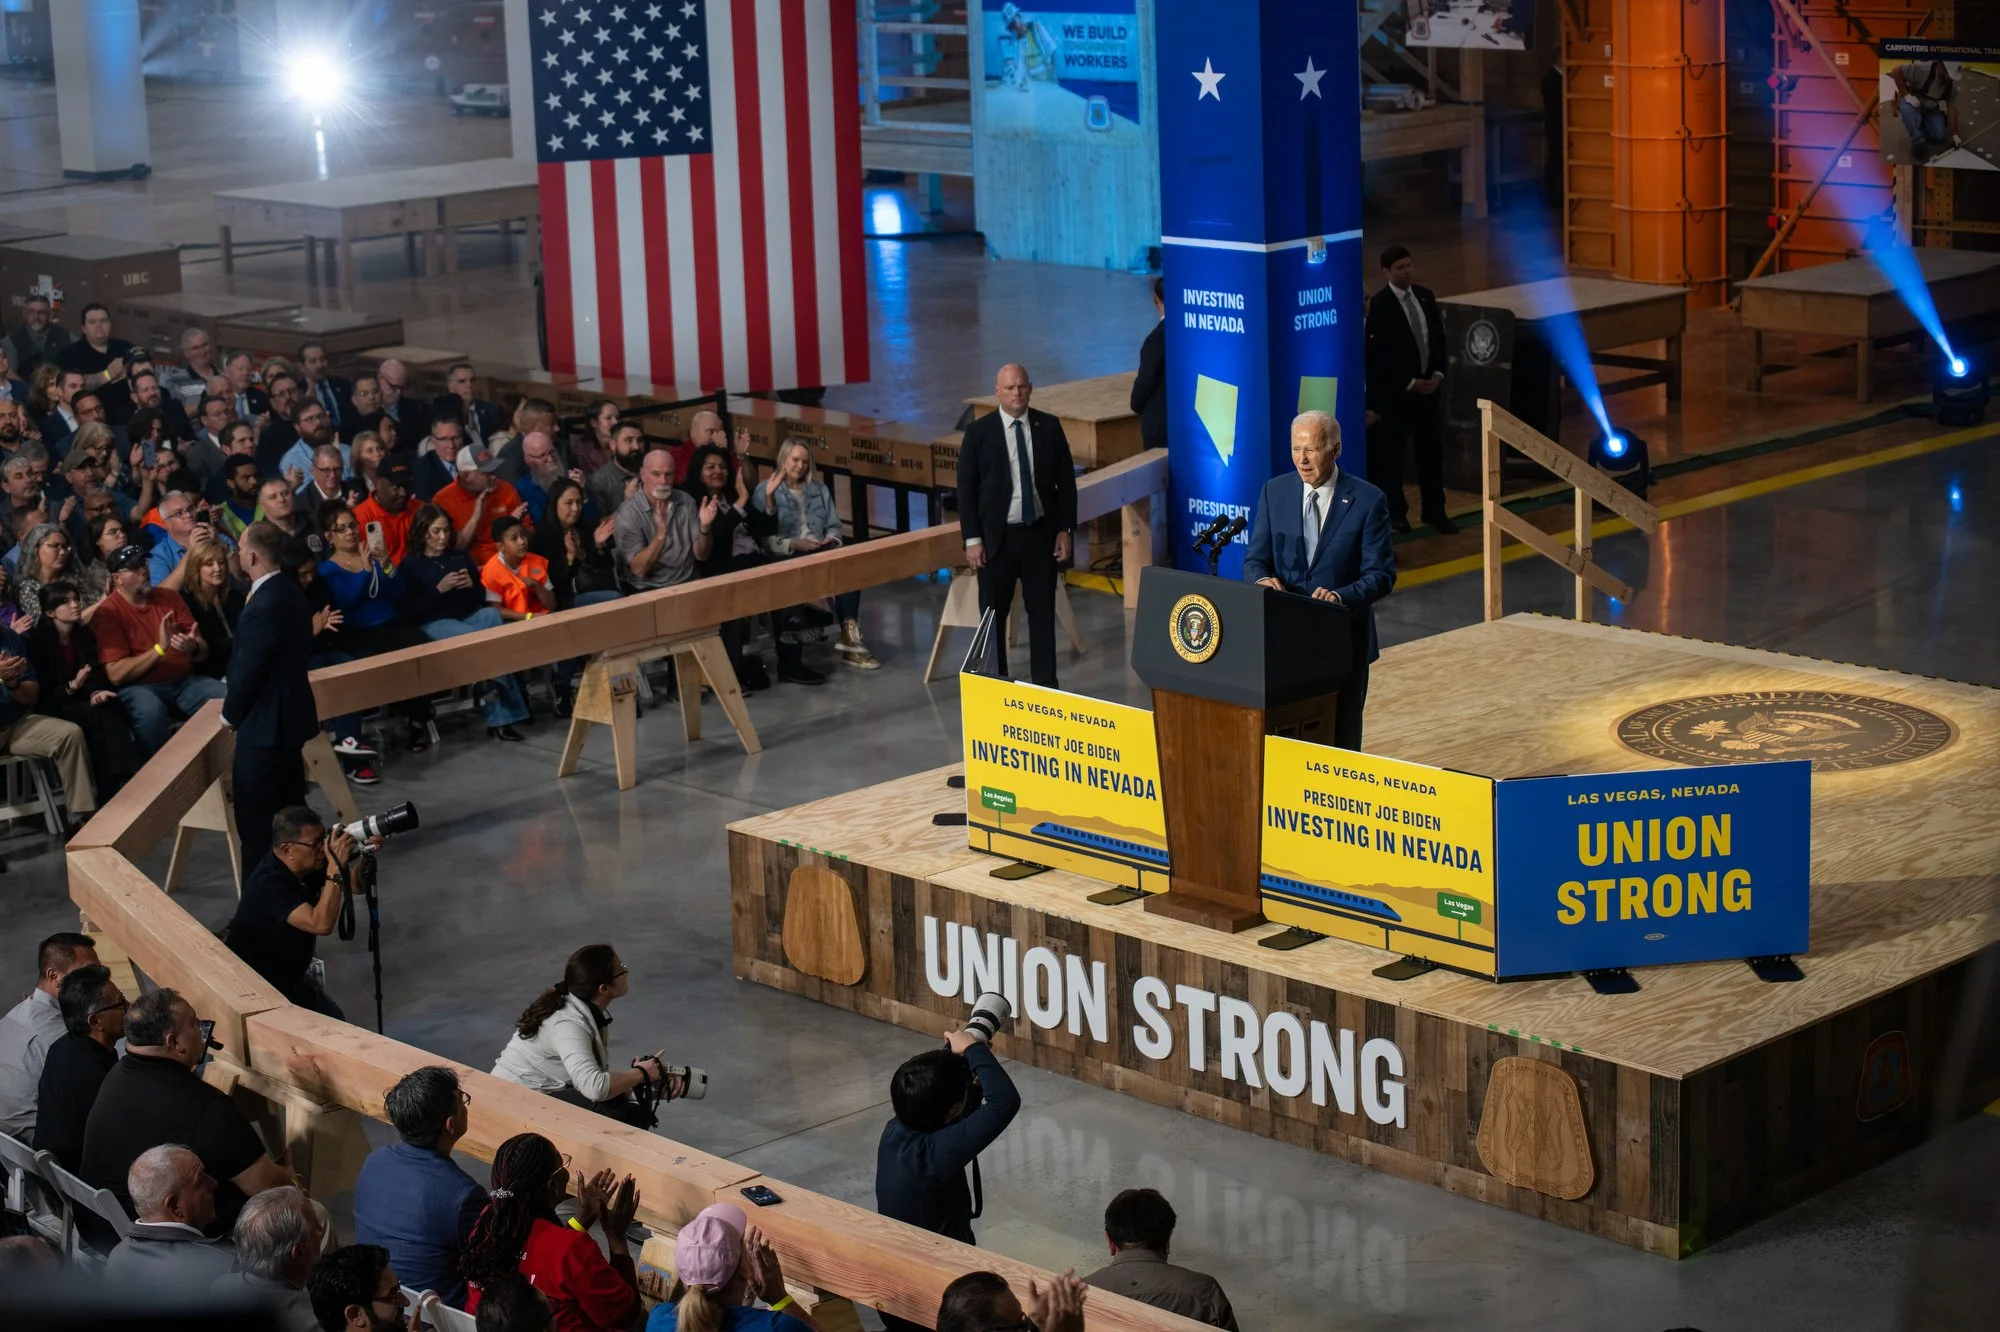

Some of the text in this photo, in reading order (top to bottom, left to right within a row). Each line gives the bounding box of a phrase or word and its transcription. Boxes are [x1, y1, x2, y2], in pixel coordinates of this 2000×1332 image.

[1062, 25, 1128, 40] WE BUILD
[1885, 44, 1929, 53] CARPENTERS
[1929, 46, 1982, 54] INTERNATIONAL
[1063, 53, 1129, 69] WORKERS
[122, 271, 149, 286] UBC
[1183, 288, 1245, 310] INVESTING
[1298, 286, 1333, 307] UNION
[1184, 312, 1245, 334] IN NEVADA
[1294, 309, 1338, 331] STRONG
[1188, 497, 1251, 522] PRESIDENT
[1172, 596, 1195, 622] PRESIDENT
[1208, 607, 1219, 637] UNITED
[1668, 692, 1871, 710] PRESIDENT
[1873, 702, 1903, 710] OF
[1004, 697, 1116, 730] LAS VEGAS, NEVADA
[1901, 709, 1932, 722] THE
[1627, 720, 1647, 730] OF
[1002, 724, 1121, 762] PRESIDENT JOE BIDEN
[1622, 730, 1675, 757] SEAL
[1884, 723, 1947, 760] UNITED
[972, 739, 1157, 801] INVESTING IN NEVADA
[1306, 760, 1437, 797] LAS VEGAS, NEVADA
[984, 790, 1013, 804] Los Angeles
[1567, 783, 1741, 806] LAS VEGAS, NEVADA
[1304, 789, 1441, 832] PRESIDENT JOE BIDEN
[1267, 805, 1483, 874] INVESTING IN NEVADA
[1578, 813, 1732, 867] UNION
[1444, 898, 1474, 912] Las Vegas
[1556, 868, 1752, 926] STRONG
[923, 915, 1110, 1043] UNION
[1132, 975, 1407, 1129] STRONG
